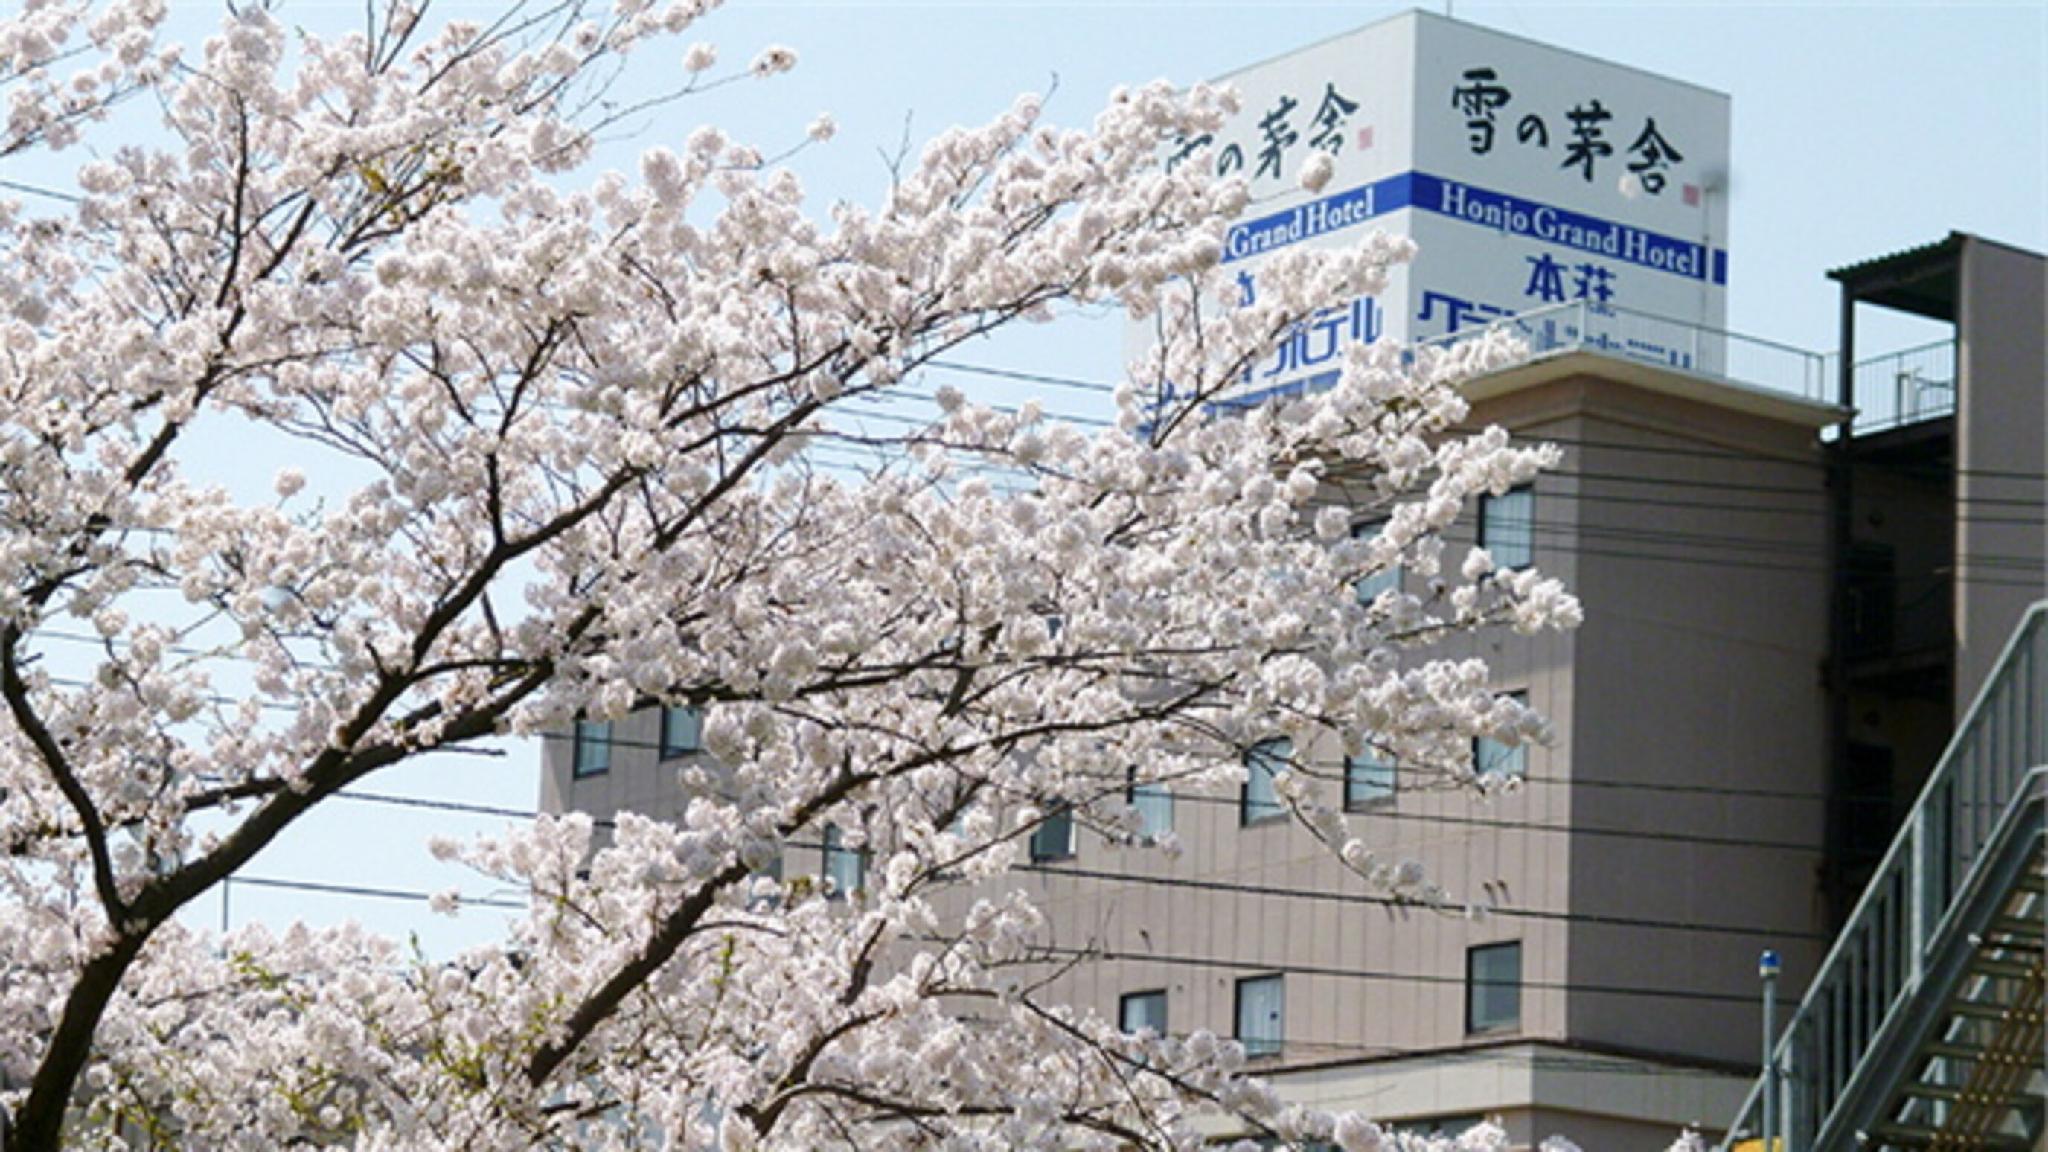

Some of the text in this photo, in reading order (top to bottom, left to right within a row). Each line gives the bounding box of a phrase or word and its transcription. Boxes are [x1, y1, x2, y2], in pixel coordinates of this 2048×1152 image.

[1230, 185, 1375, 257] Grand Hotel
[1440, 181, 1699, 276] Honjo Grand Hotel
